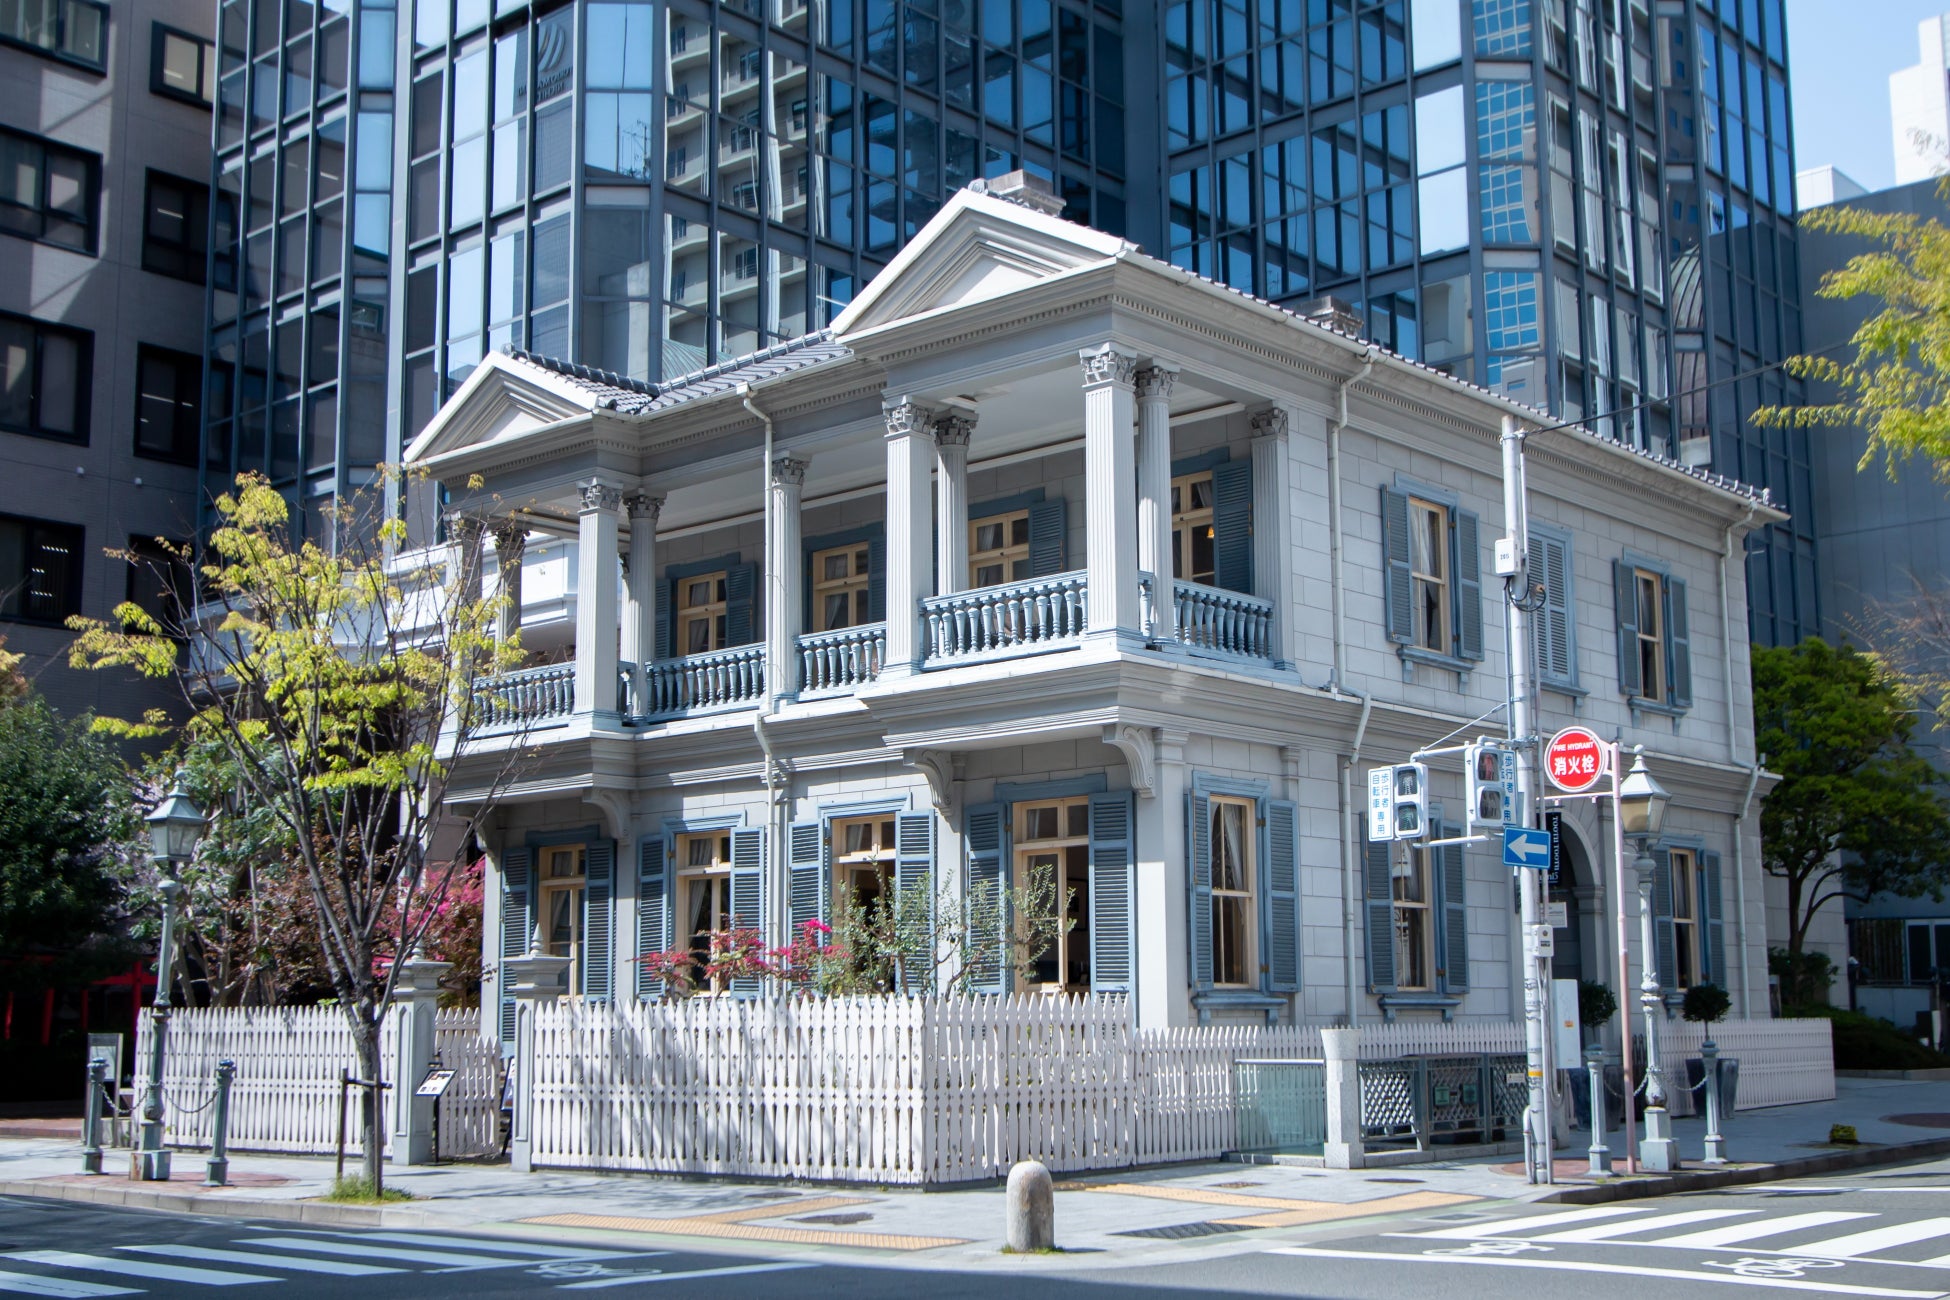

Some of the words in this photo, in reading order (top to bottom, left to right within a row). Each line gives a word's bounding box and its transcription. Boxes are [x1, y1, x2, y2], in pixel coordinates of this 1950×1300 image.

[1553, 744, 1566, 752] FIRE
[1567, 742, 1595, 751] HYDRANT
[1554, 754, 1595, 776] 消火栓
[1372, 774, 1381, 809] 自転車
[1381, 773, 1390, 808] 歩行者
